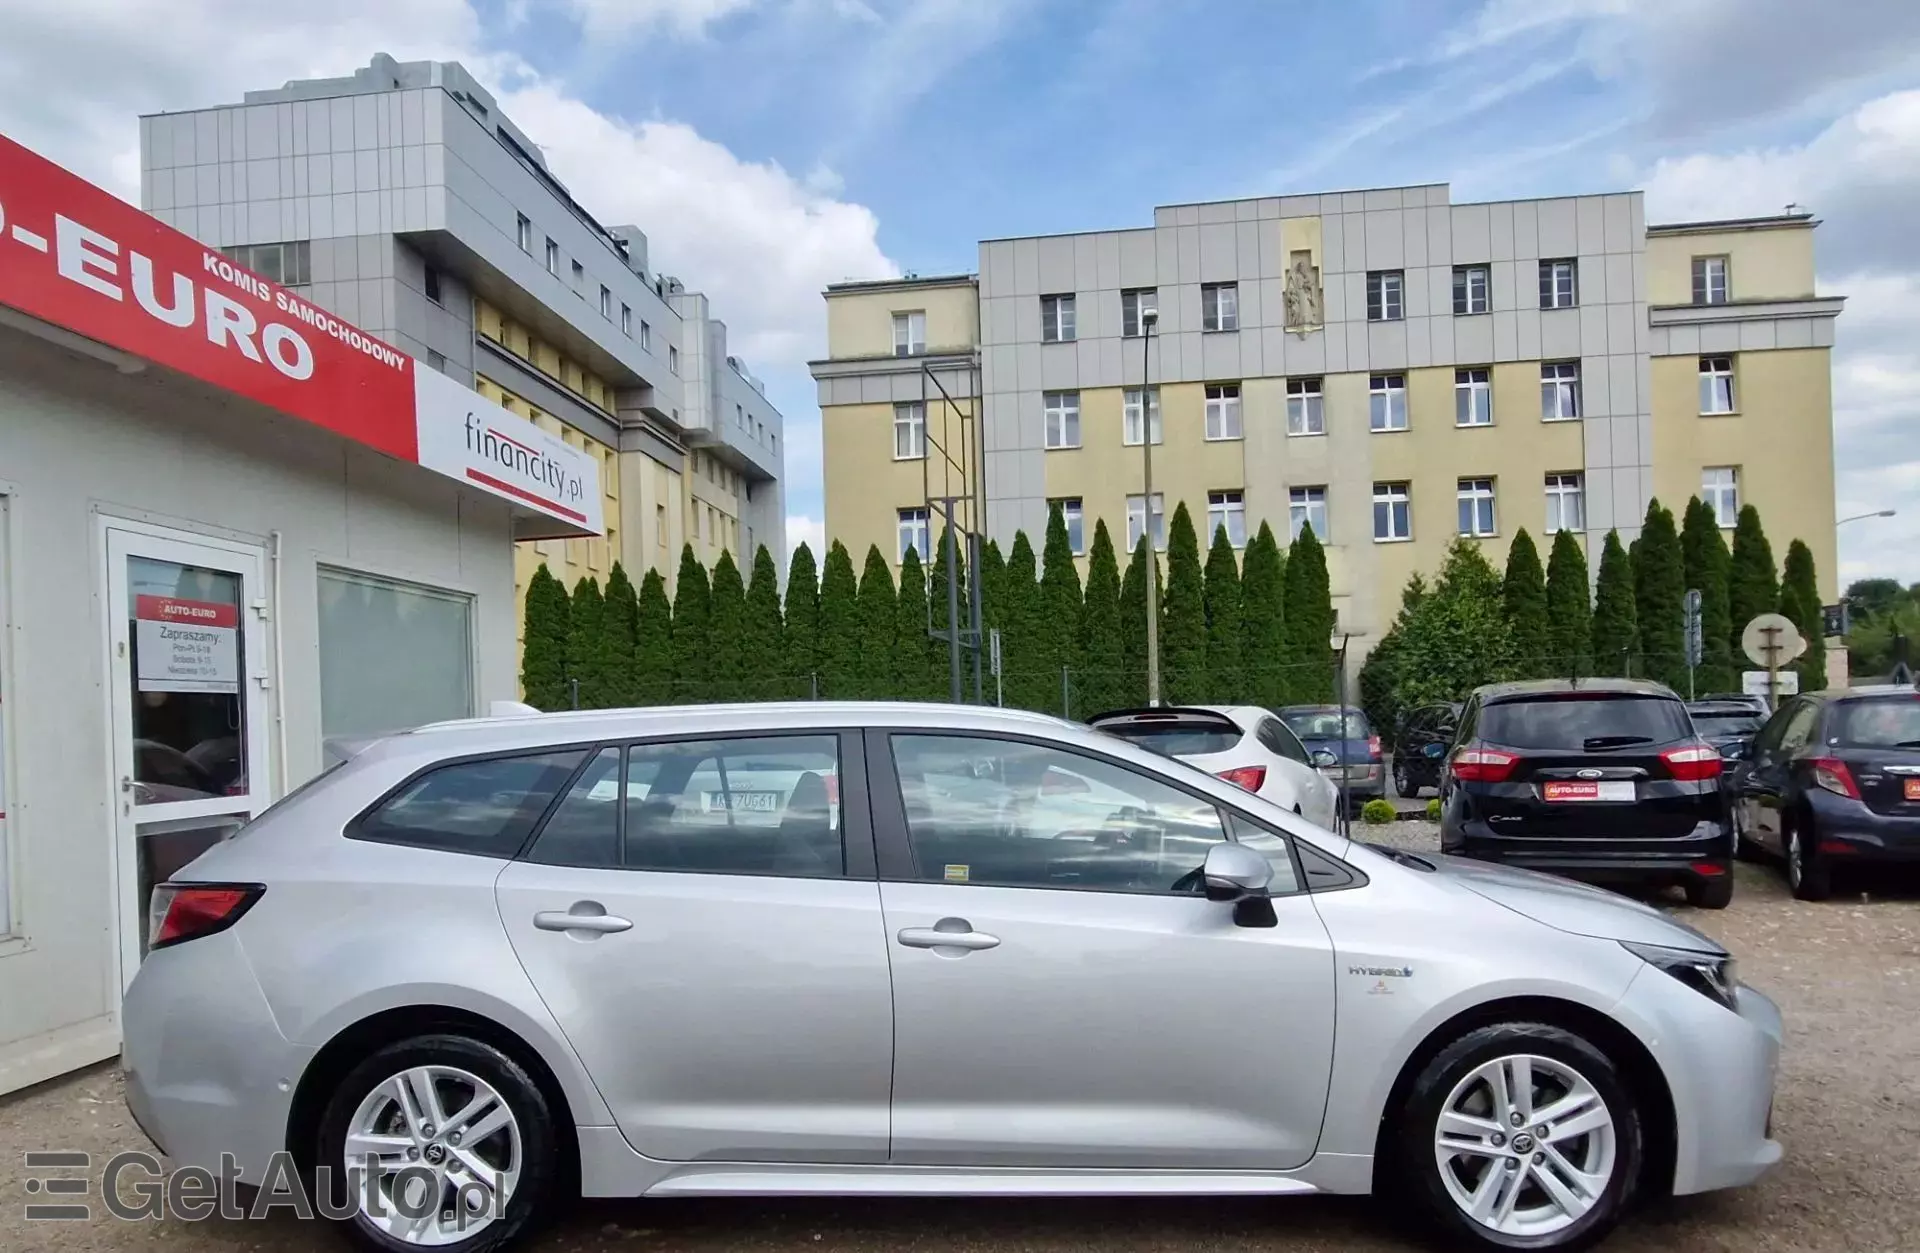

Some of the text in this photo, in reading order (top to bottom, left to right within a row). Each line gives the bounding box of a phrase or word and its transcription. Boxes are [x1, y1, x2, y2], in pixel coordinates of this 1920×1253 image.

[0, 202, 313, 380] -EURO
[203, 252, 405, 371] KOMIS SAMOCHODOWY
[465, 412, 583, 501] financity.pl
[164, 604, 217, 619] AUTO-EURO
[1549, 786, 1597, 794] AUTO-EURO
